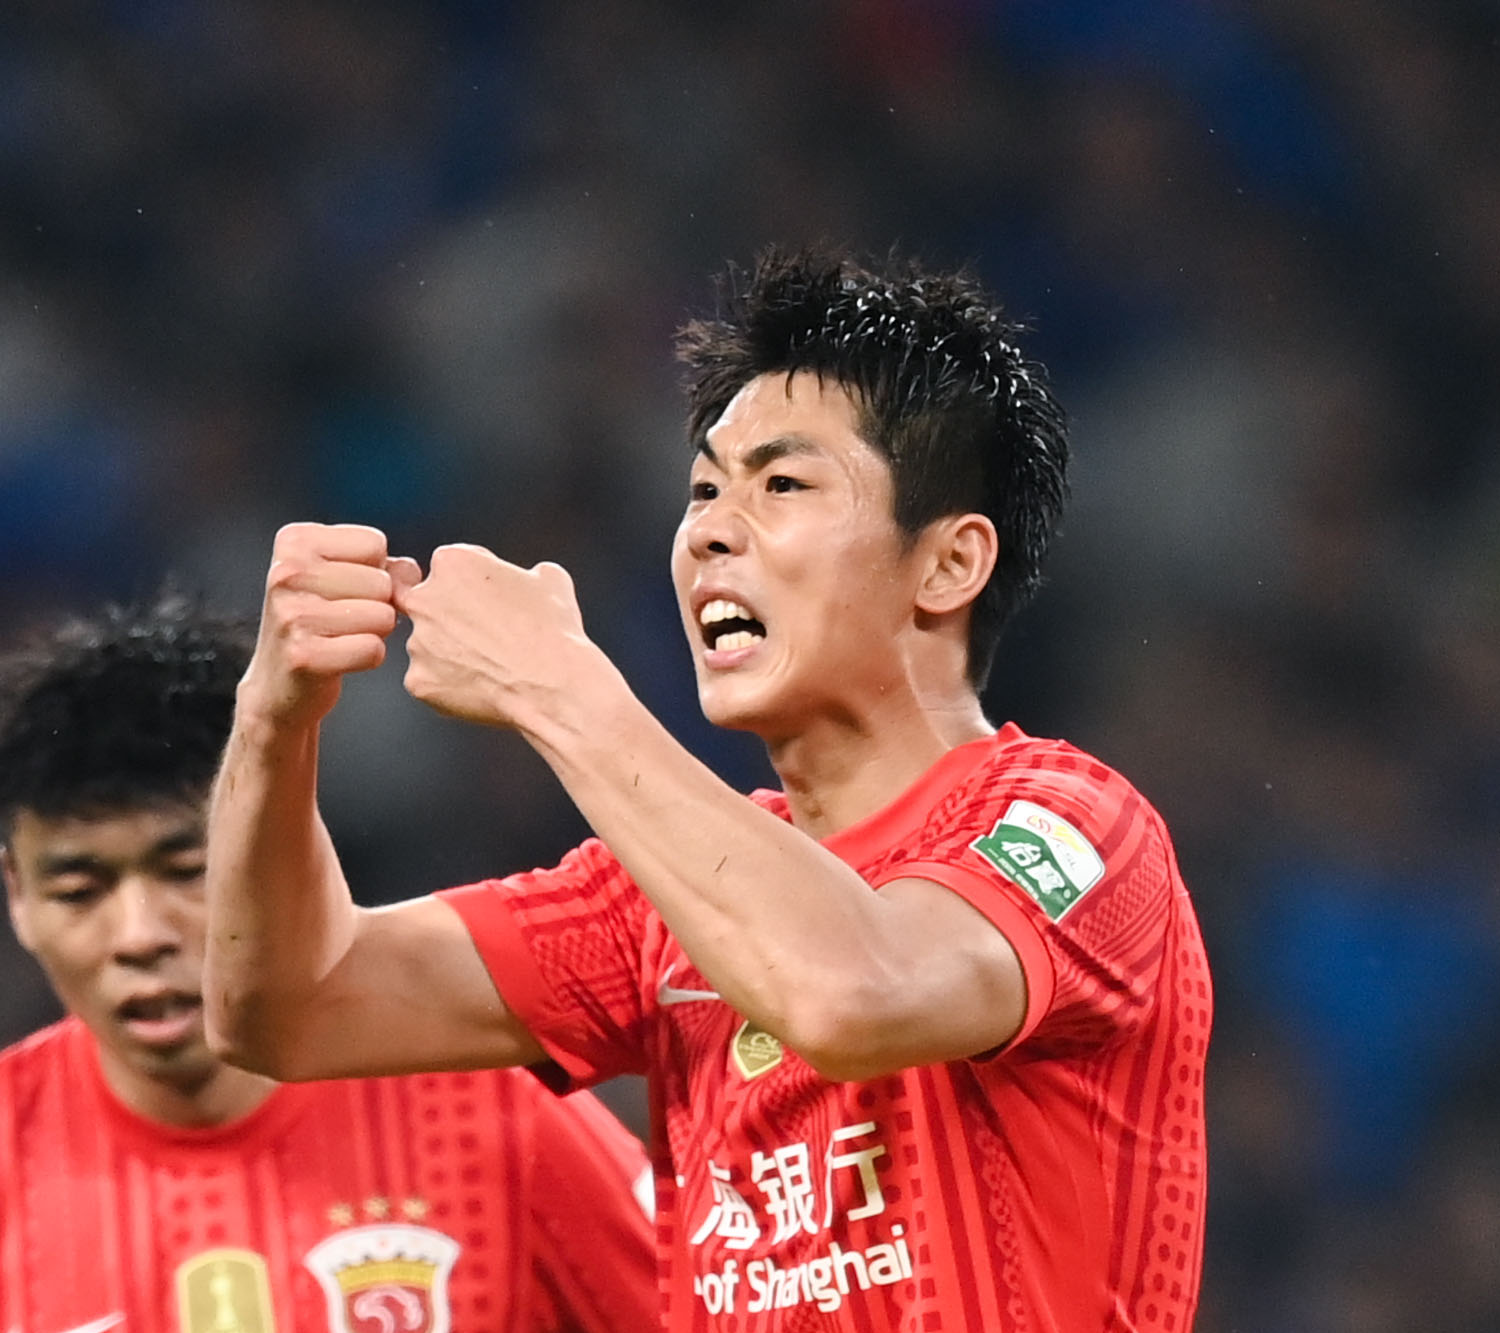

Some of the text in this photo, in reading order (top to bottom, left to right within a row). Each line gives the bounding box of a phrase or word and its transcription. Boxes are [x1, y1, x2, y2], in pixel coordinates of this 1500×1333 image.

[677, 1121, 886, 1250] 海银行
[702, 1224, 913, 1314] of Shanghai
